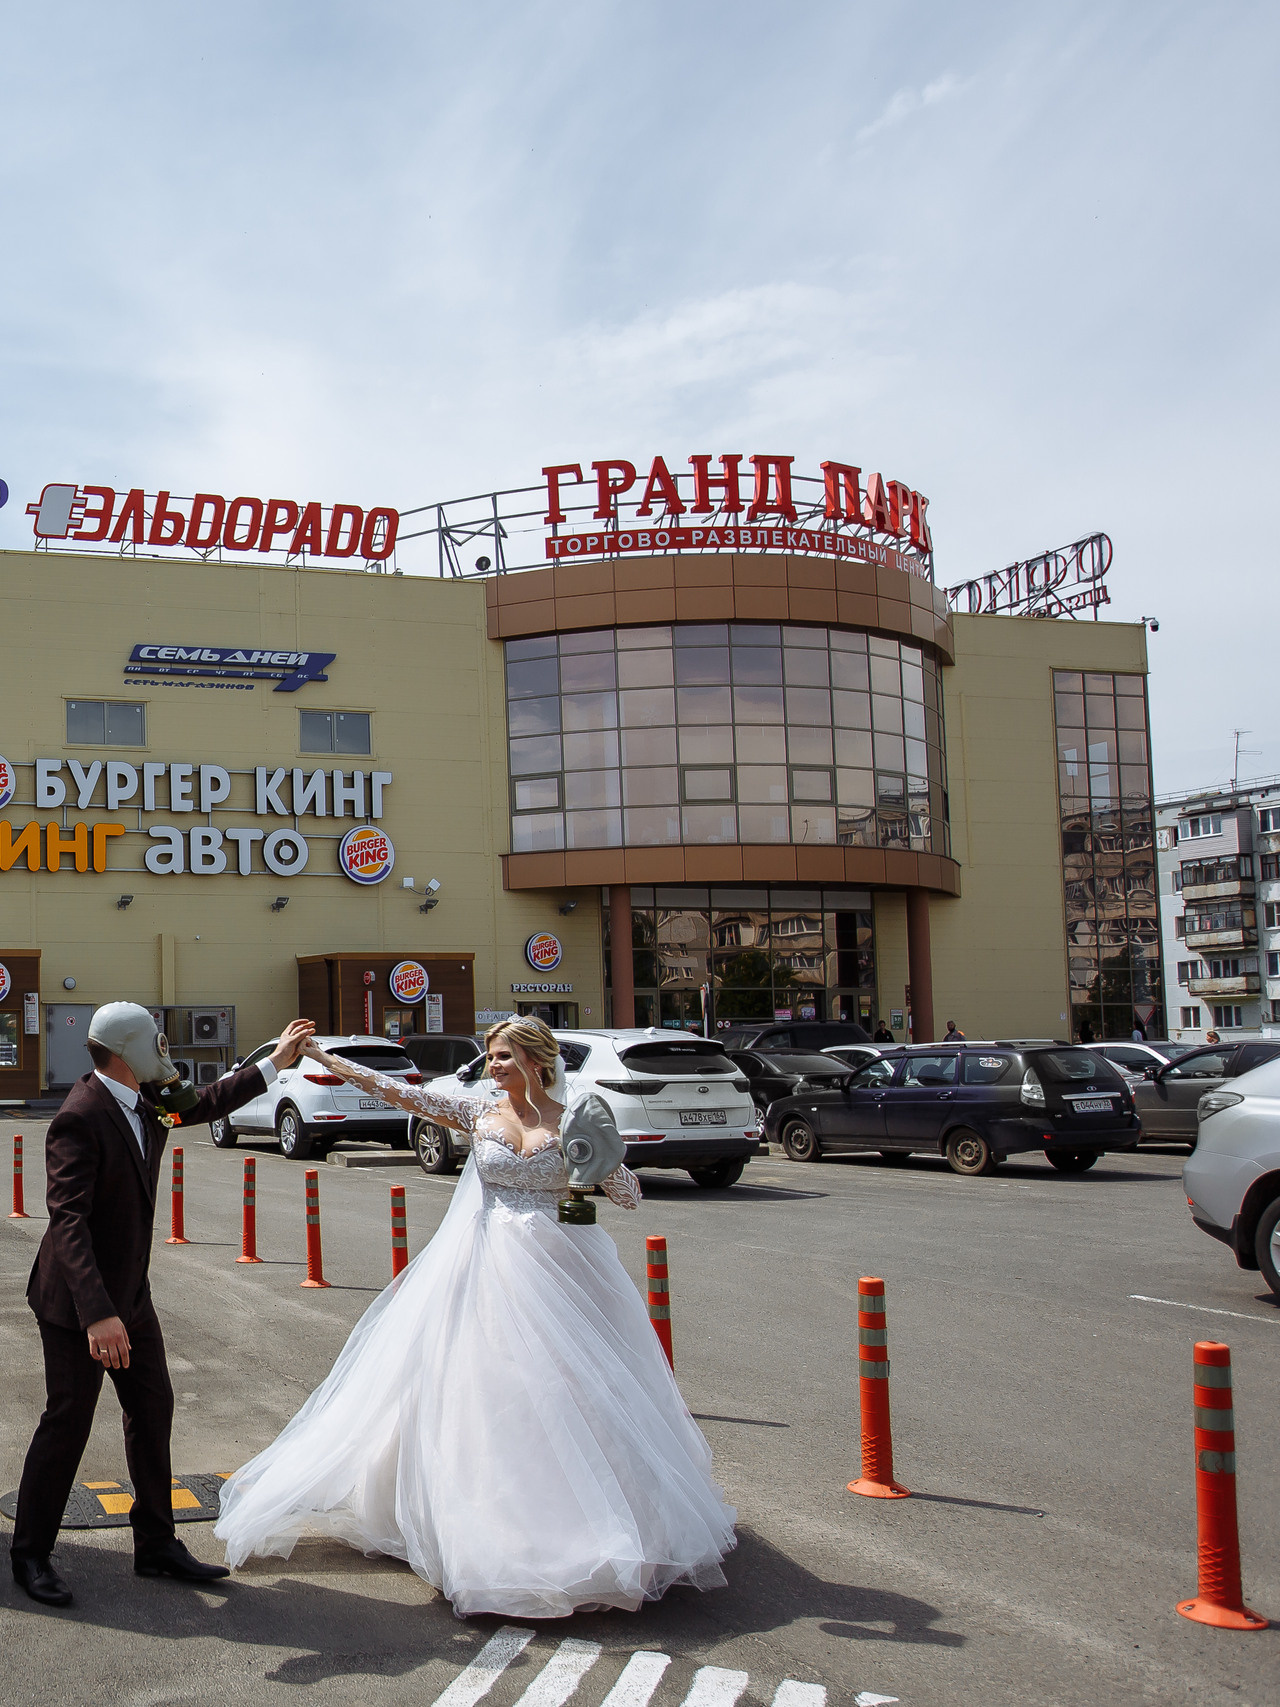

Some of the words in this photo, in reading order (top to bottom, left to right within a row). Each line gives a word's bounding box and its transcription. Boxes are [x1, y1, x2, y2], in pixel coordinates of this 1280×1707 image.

[542, 454, 798, 524] ГРАНД
[820, 460, 933, 554] ПАРК
[138, 646, 221, 662] СЕМЬ
[223, 650, 310, 666] ДНЕЙ
[35, 758, 231, 813] БУРГЕР
[256, 765, 393, 819] КИНГ
[346, 837, 387, 855] BURGER
[347, 847, 389, 872] KING
[531, 940, 557, 954] BURGER
[532, 946, 559, 963] KING
[394, 969, 424, 984] BURGER
[396, 975, 425, 994] KING
[511, 983, 573, 993] РЕСТОРАН
